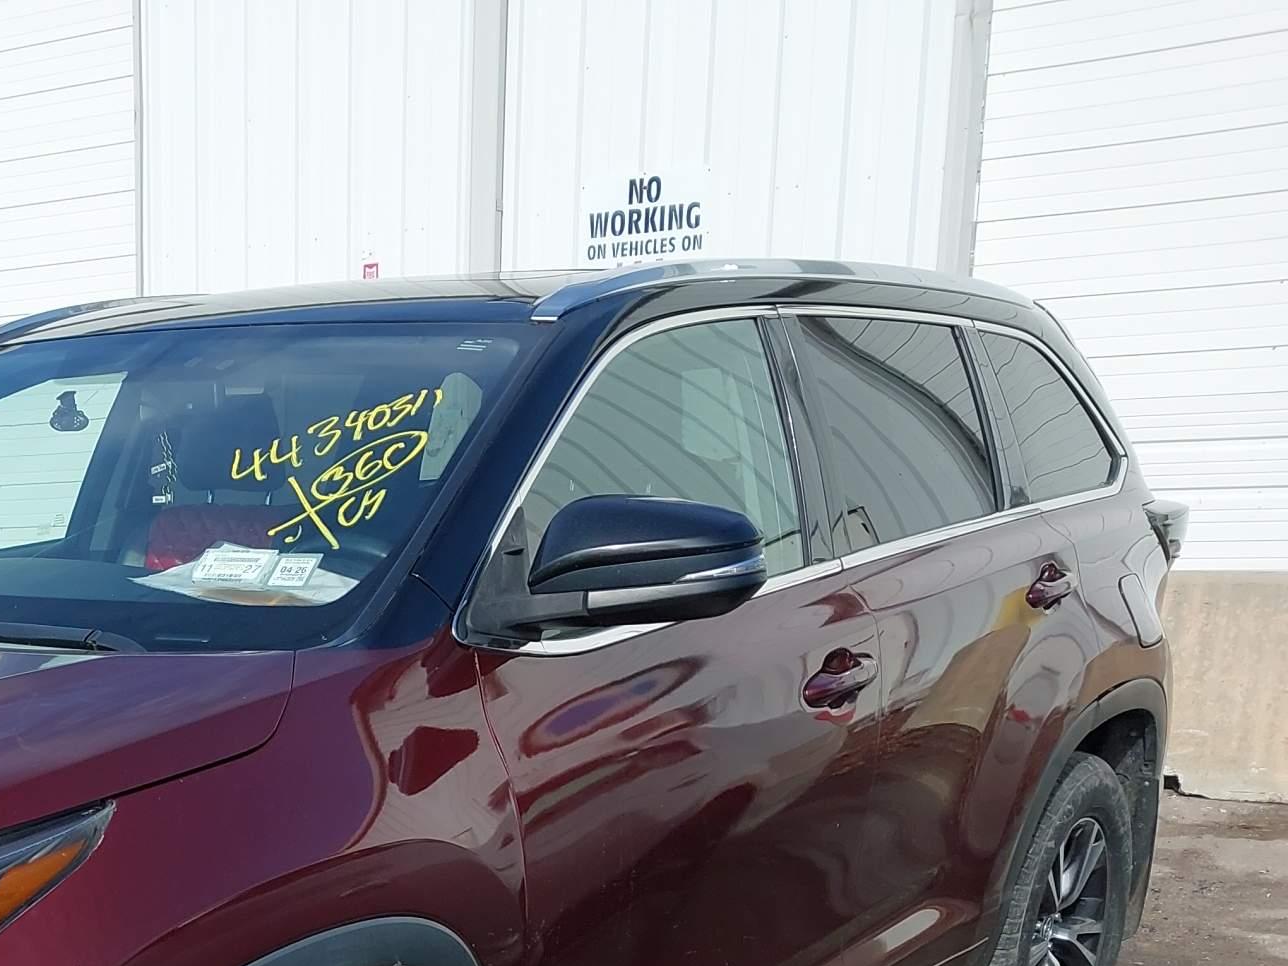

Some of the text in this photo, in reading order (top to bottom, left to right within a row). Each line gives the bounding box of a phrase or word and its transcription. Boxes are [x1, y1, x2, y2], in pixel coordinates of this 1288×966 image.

[628, 175, 662, 205] NO
[589, 201, 701, 239] WORKING
[587, 233, 703, 261] ON VEHICLES ON
